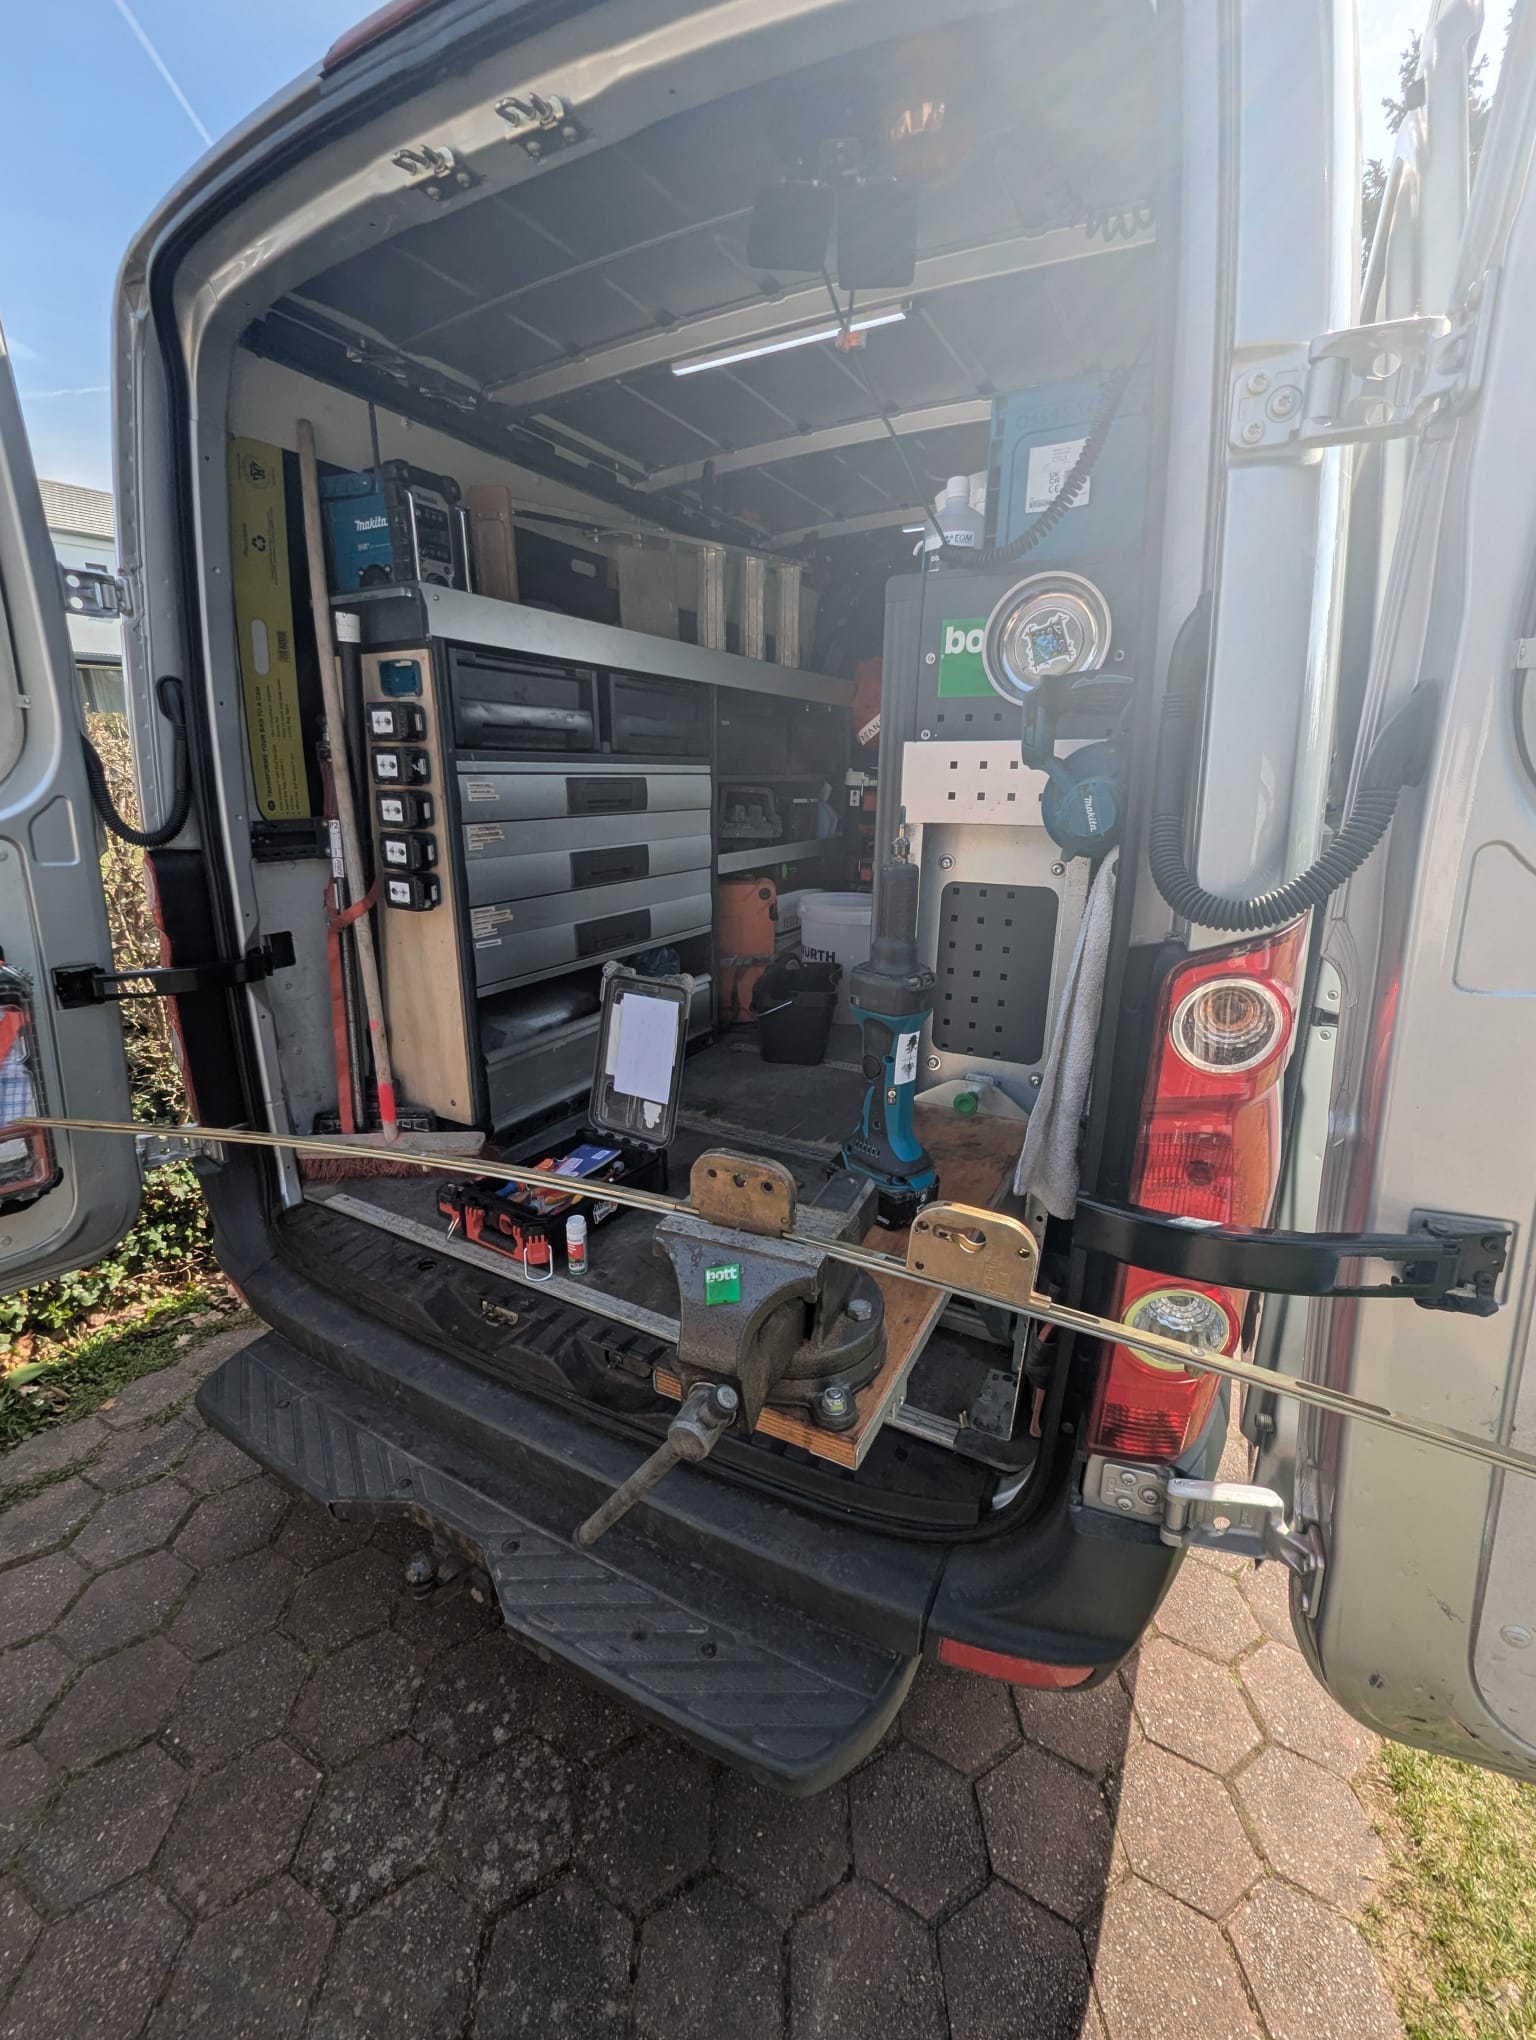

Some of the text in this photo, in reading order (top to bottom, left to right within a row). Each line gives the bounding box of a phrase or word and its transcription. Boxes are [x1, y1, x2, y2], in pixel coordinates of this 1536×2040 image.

[354, 515, 389, 532] makita
[944, 624, 985, 655] bo
[1083, 794, 1098, 833] makita
[705, 1266, 738, 1284] bott
